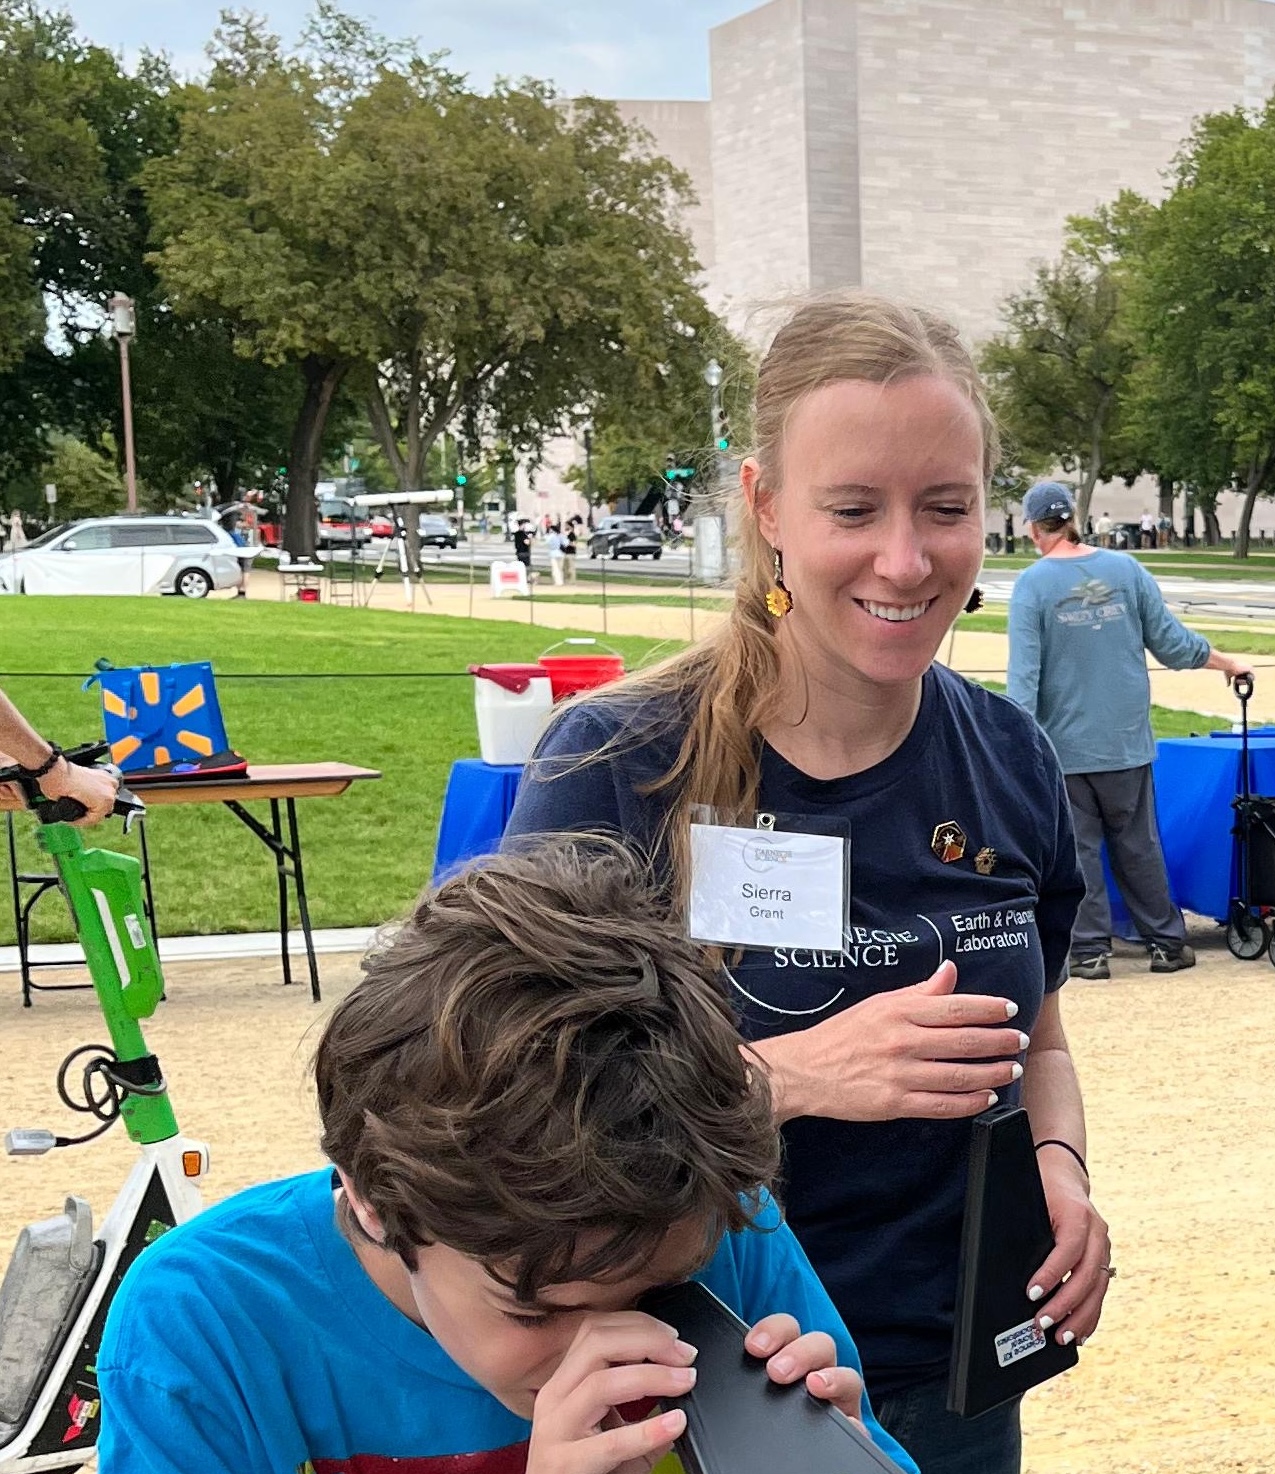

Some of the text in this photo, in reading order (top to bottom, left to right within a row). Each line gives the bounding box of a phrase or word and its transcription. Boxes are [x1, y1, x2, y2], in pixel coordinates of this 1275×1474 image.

[741, 882, 792, 902] Sierra
[749, 905, 785, 920] Grant
[950, 911, 991, 933] Earth
[993, 913, 1003, 928] &
[842, 925, 919, 945] NEGIE
[954, 931, 1030, 953] Laboratory
[774, 943, 900, 969] SCIENCE
